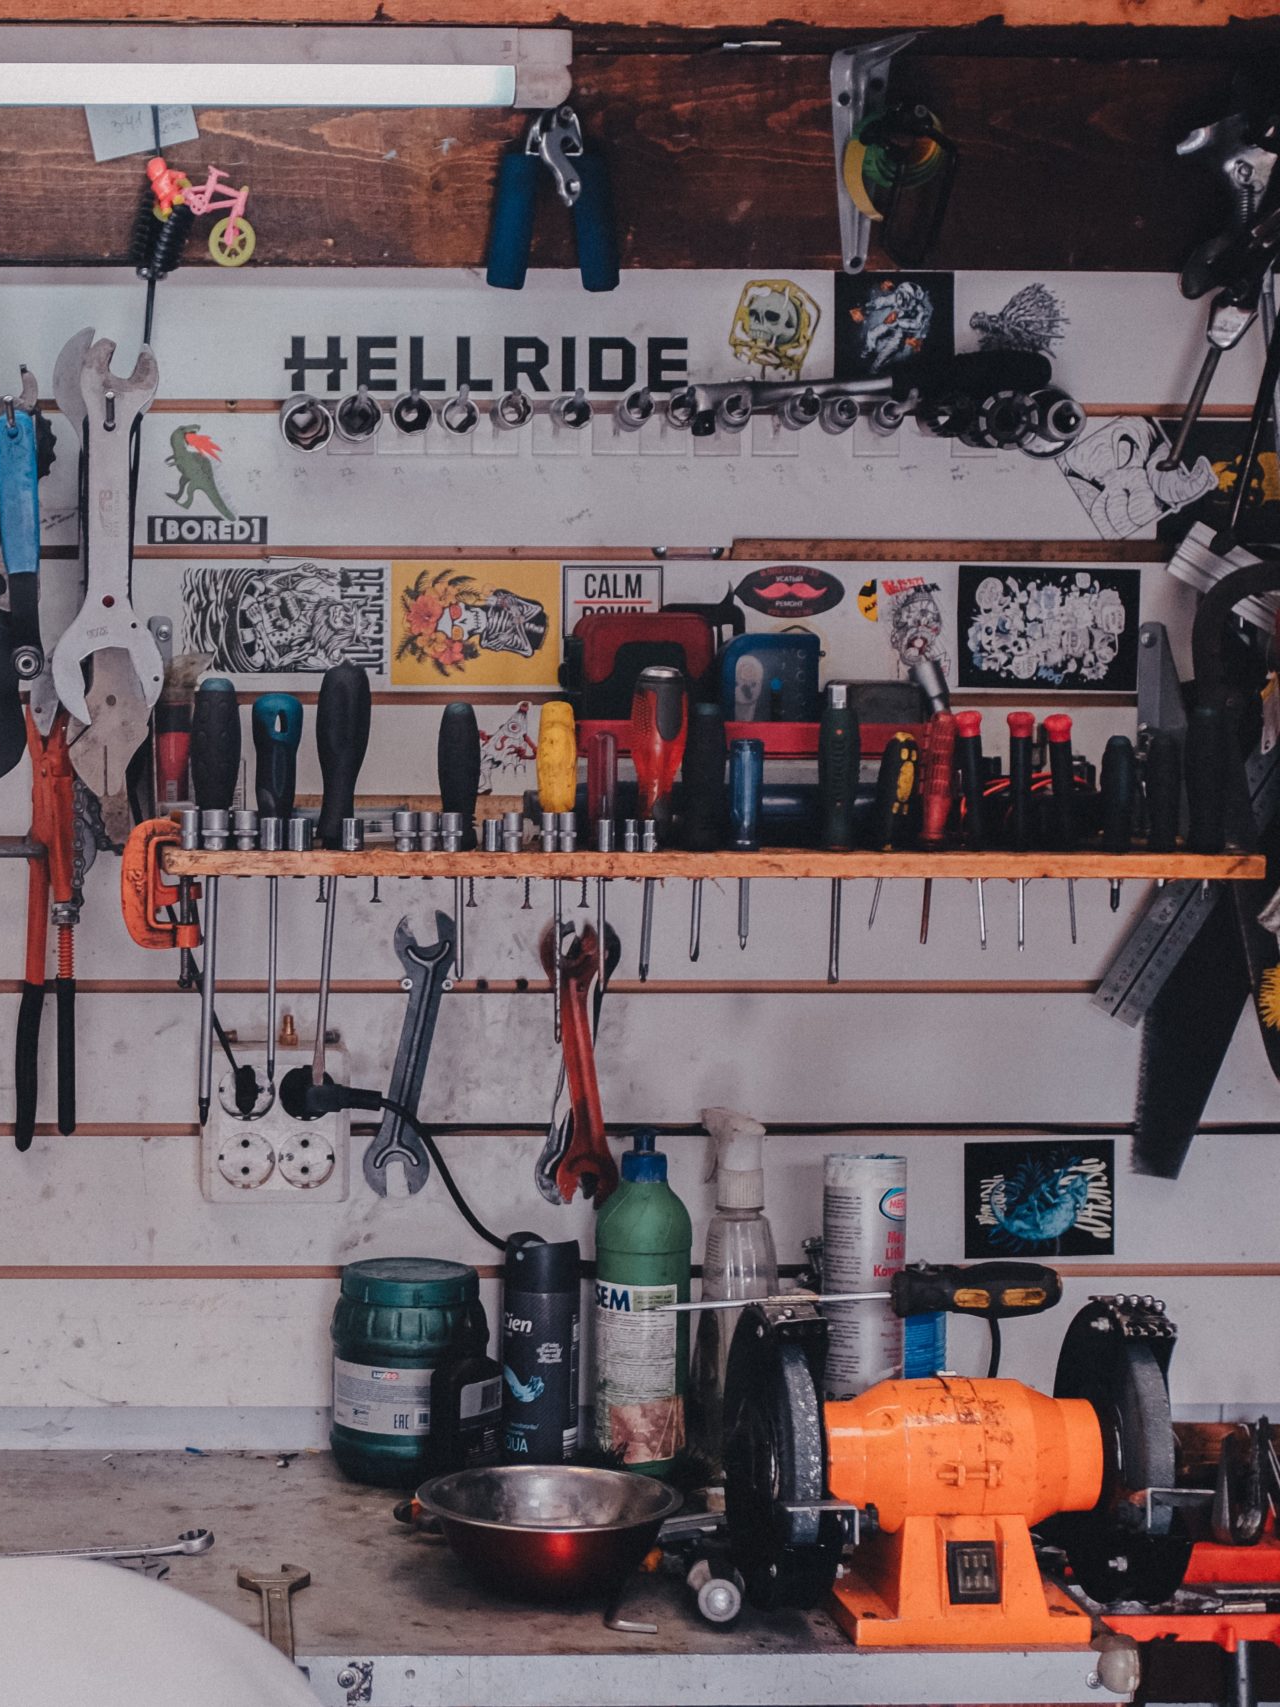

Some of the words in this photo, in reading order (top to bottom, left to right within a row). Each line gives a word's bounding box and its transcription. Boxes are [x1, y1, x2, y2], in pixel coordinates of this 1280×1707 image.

[284, 335, 688, 392] HELLRIDE
[584, 573, 642, 599] CALM
[393, 1414, 410, 1430] EAC
